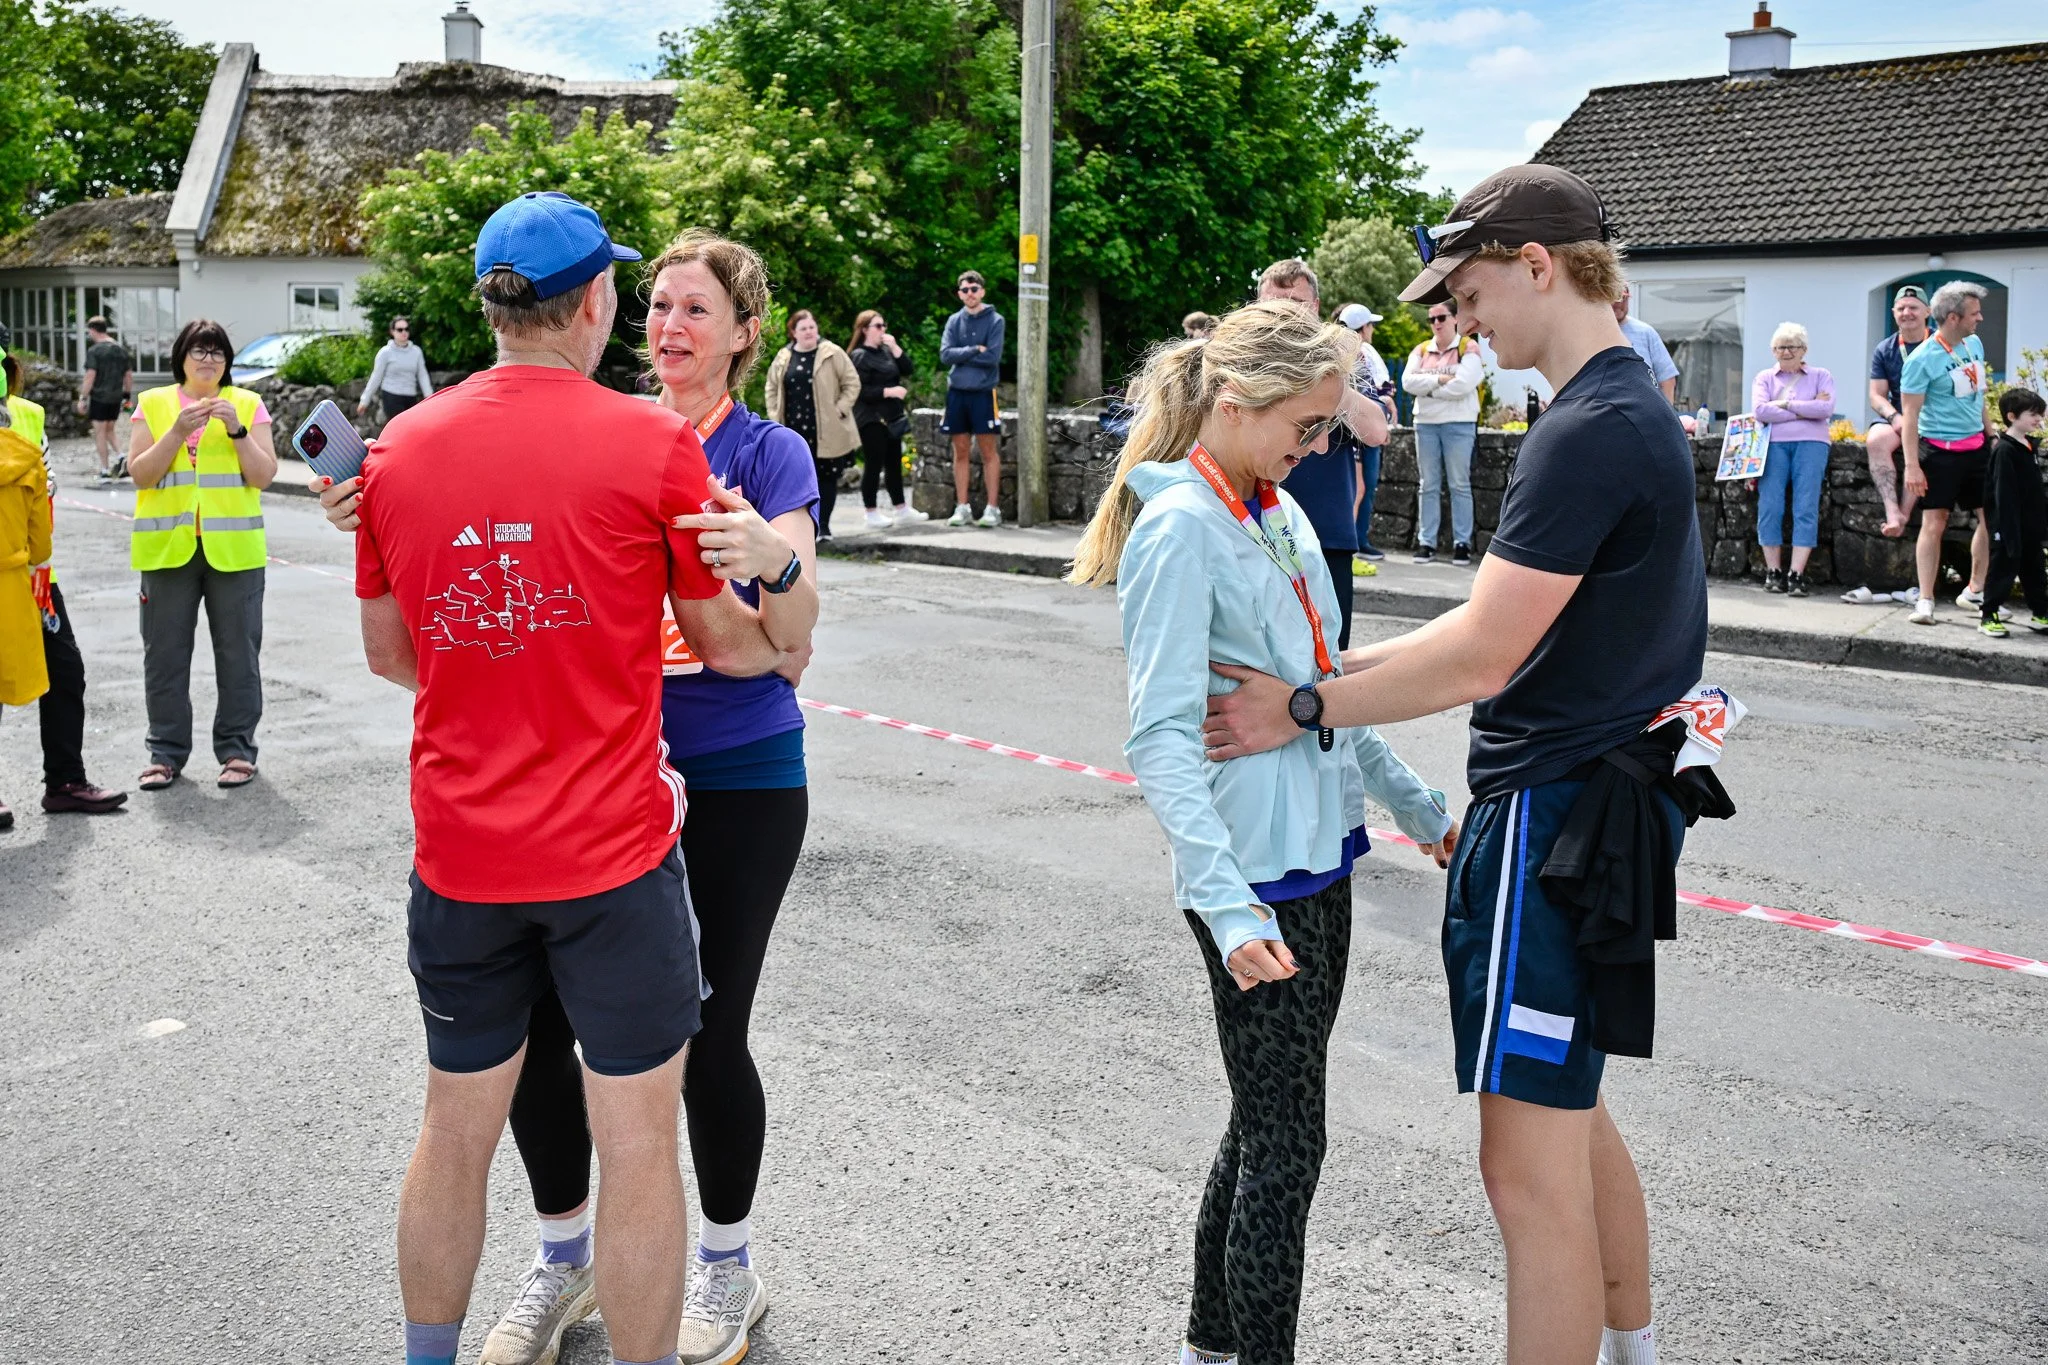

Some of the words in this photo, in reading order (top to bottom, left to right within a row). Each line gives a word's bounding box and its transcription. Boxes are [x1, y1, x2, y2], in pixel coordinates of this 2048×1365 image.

[1198, 454, 1217, 475] CLARE
[1214, 472, 1236, 502] BURREN
[494, 523, 532, 533] STOCKHOLM
[494, 532, 532, 542] MARATHON
[1279, 525, 1298, 557] MONKS
[1700, 688, 1721, 696] CLAR
